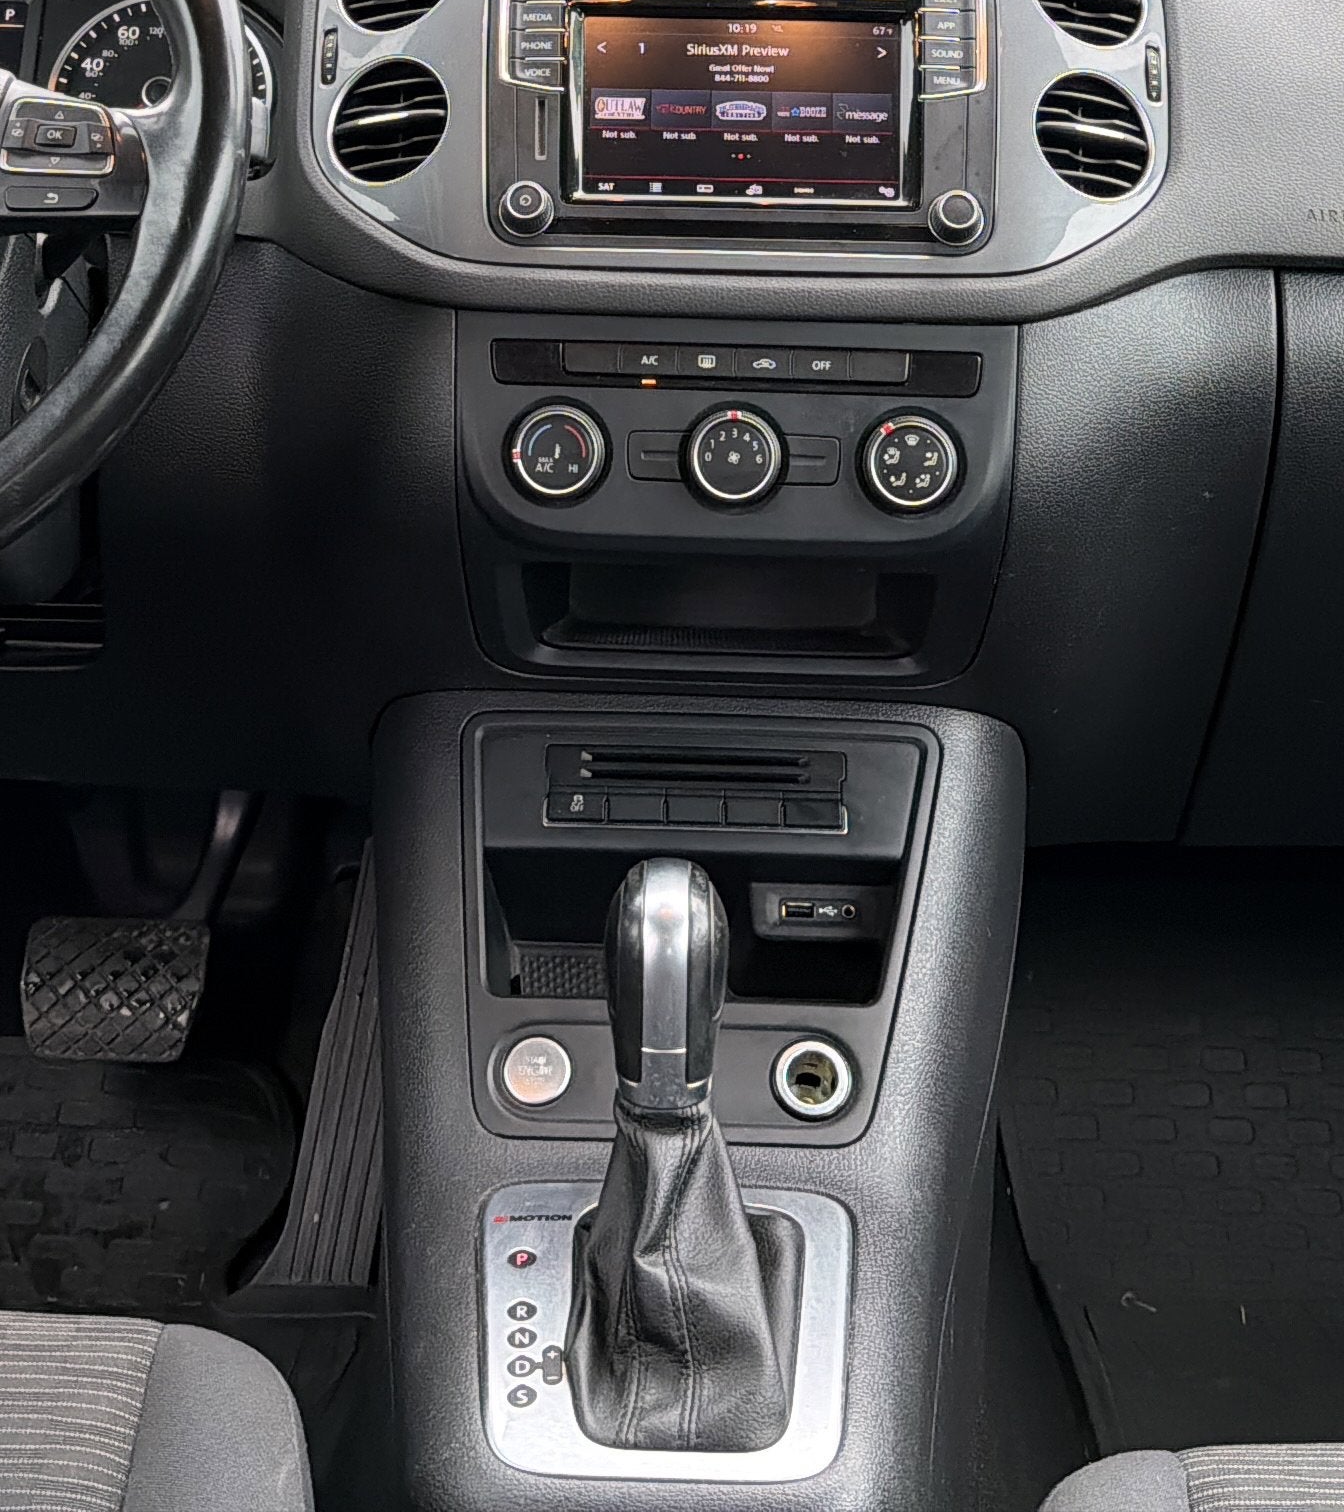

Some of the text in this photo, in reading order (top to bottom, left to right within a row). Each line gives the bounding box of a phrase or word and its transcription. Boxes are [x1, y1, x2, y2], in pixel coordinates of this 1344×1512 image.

[5, 8, 16, 21] P
[522, 13, 552, 21] MEDIA
[727, 23, 757, 34] 10:19
[937, 21, 955, 29] APP
[118, 25, 140, 40] 60
[149, 26, 164, 35] 120
[119, 38, 134, 46] 100
[520, 41, 552, 50] PHONE
[102, 49, 114, 57] 80
[638, 42, 645, 54] 1
[686, 43, 789, 57] SiriusXM Preview
[931, 49, 963, 58] SOUND
[81, 57, 104, 71] 40
[524, 68, 551, 76] VOICE
[933, 76, 960, 85] MENU
[79, 92, 92, 100] 40
[596, 98, 645, 113] OUTLAW
[800, 106, 826, 117] BOOZE
[47, 129, 64, 140] OK
[602, 130, 617, 138] Not
[663, 131, 679, 139] Not
[723, 133, 739, 141] Not
[784, 134, 800, 142] Not
[845, 135, 861, 143] Not
[598, 182, 615, 191] SAT
[641, 355, 659, 366] A/C
[812, 360, 832, 371] OFF
[719, 431, 726, 441] 2
[732, 428, 738, 438] 3
[743, 432, 751, 442] 4
[710, 439, 715, 449] 1
[752, 440, 759, 451] 5
[704, 451, 712, 462] 0
[756, 454, 763, 464] 6
[535, 463, 554, 473] A/C
[568, 464, 579, 473] HI
[517, 1252, 528, 1265] P
[516, 1305, 528, 1318] R
[515, 1332, 529, 1345] N
[516, 1360, 530, 1374] D
[516, 1389, 528, 1404] S
